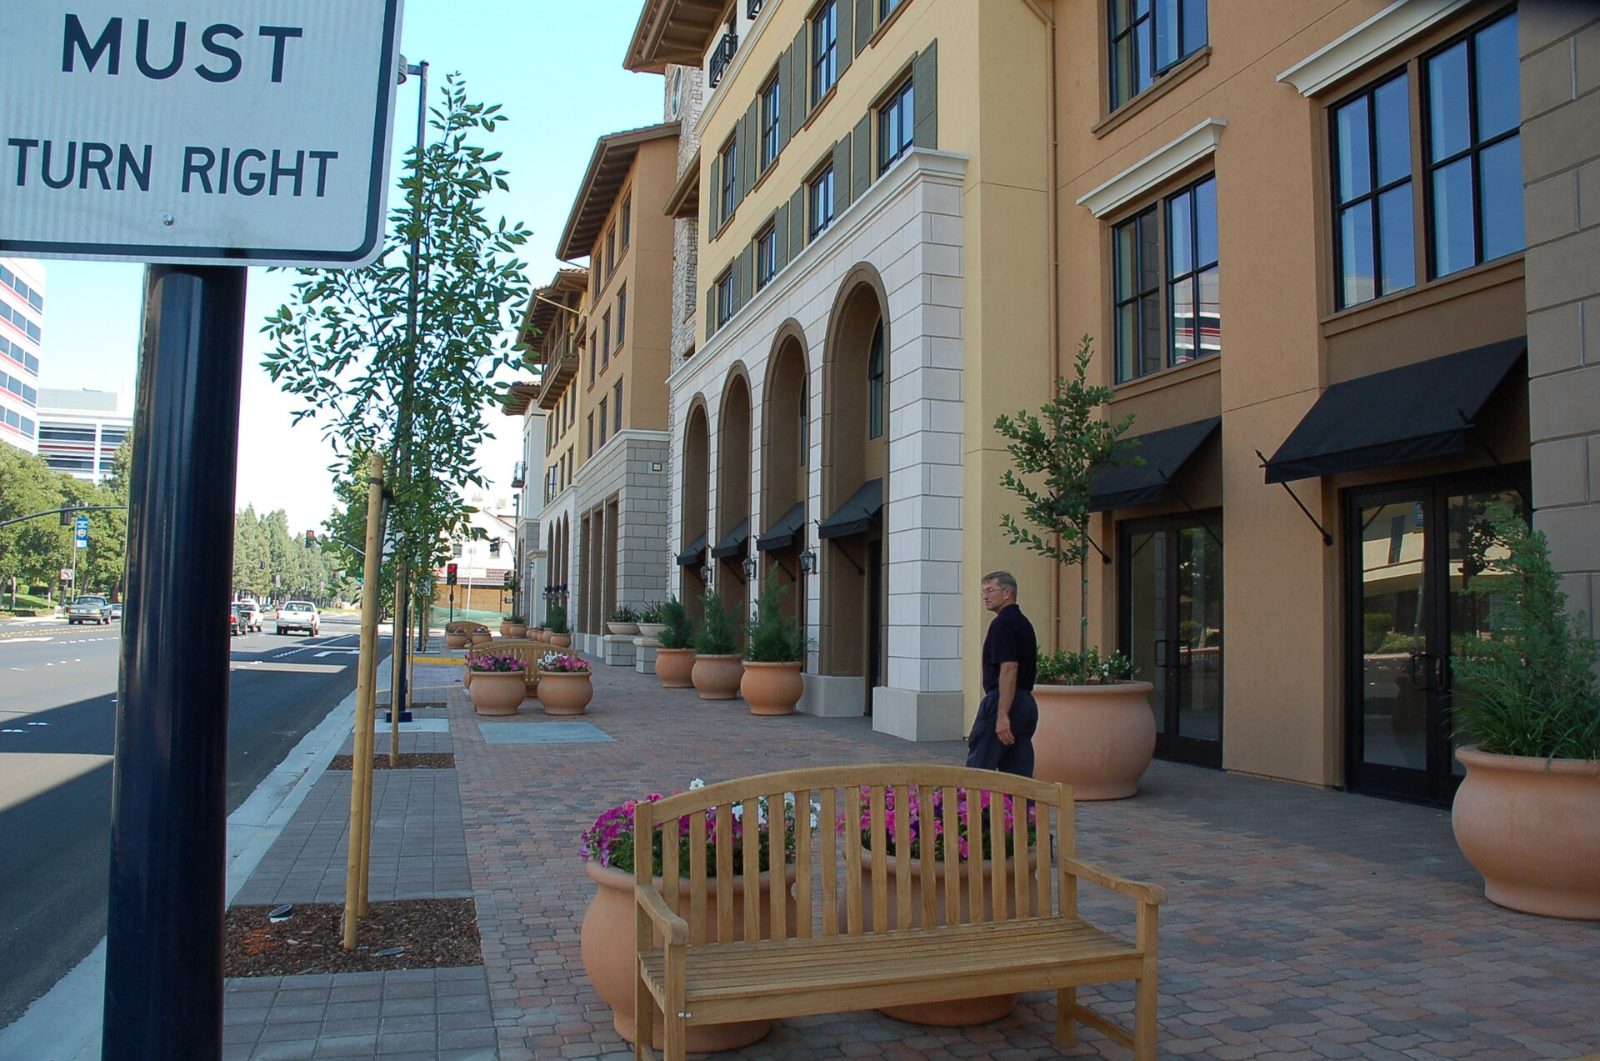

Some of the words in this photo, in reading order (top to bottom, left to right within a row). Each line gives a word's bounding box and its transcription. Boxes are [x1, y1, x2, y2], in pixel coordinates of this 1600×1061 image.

[62, 13, 303, 83] MUST
[8, 138, 152, 191] TURN
[181, 146, 338, 197] RIGHT
